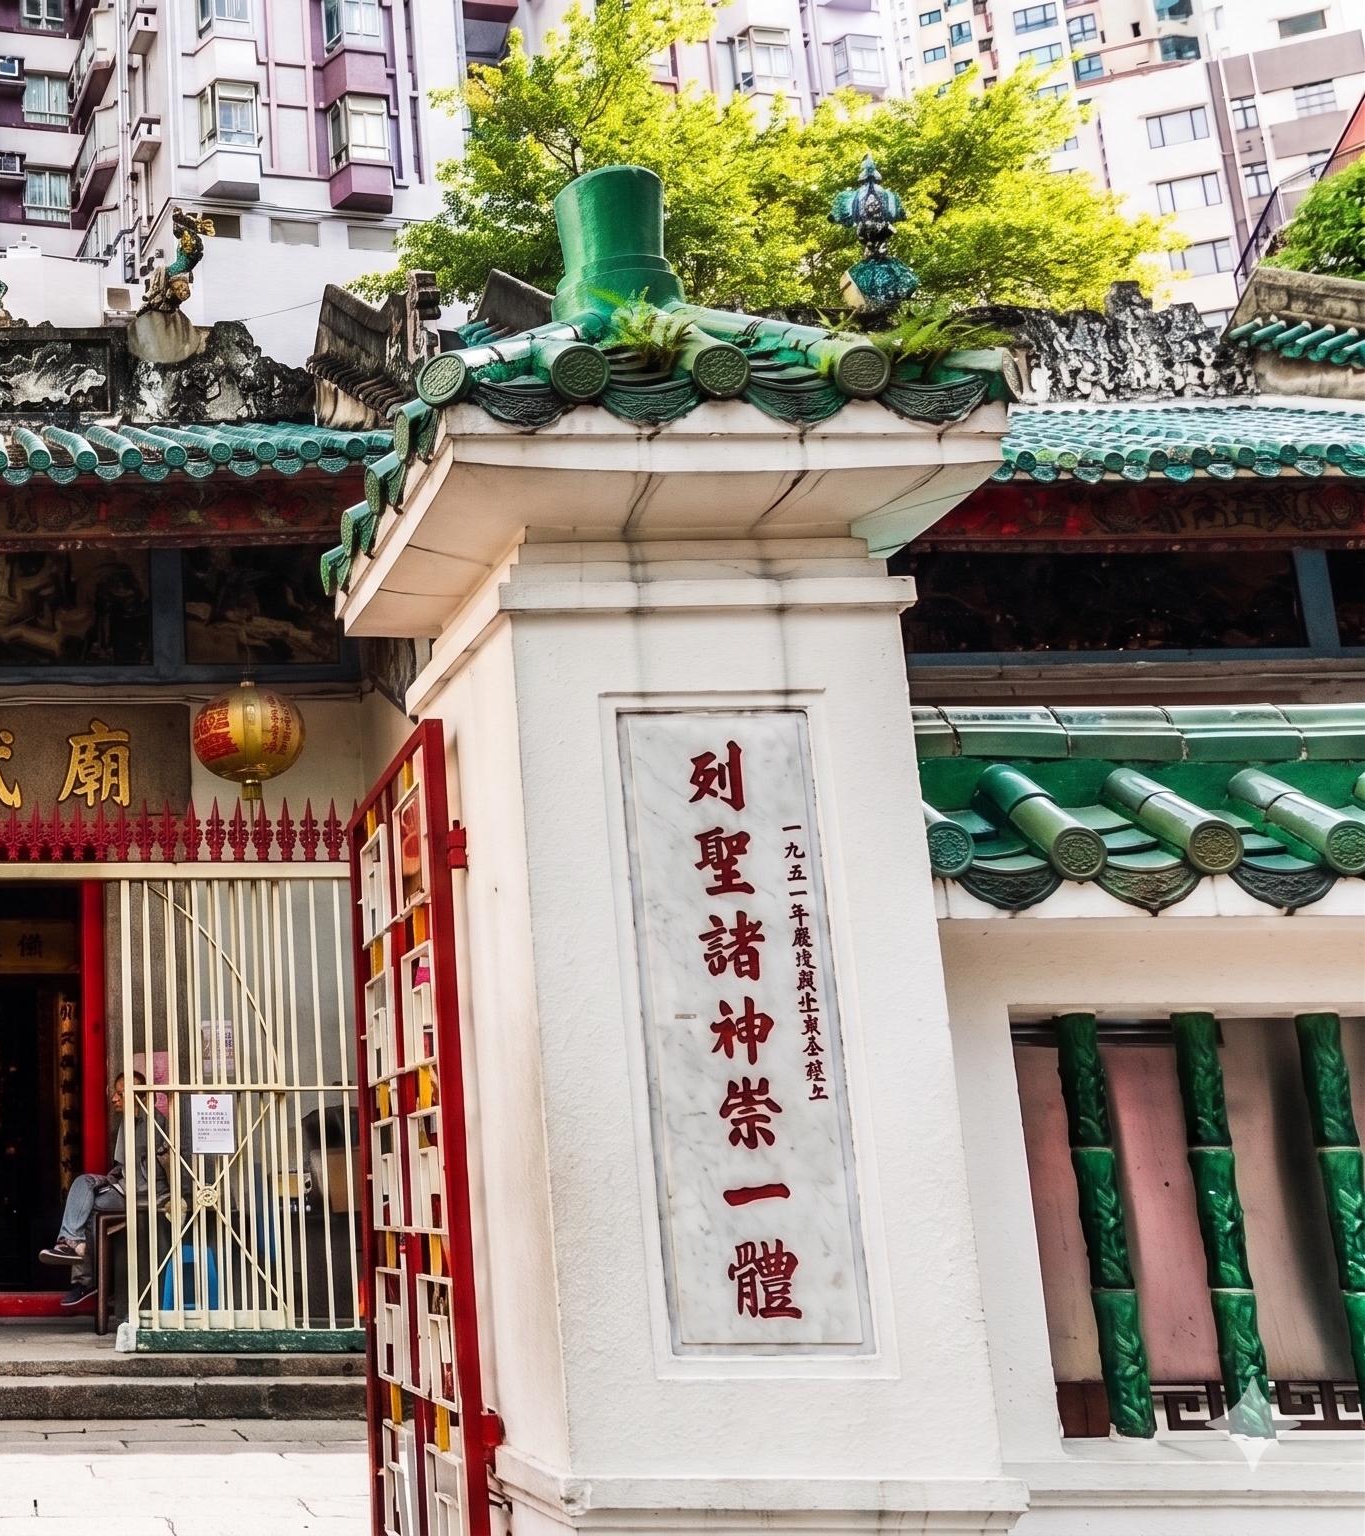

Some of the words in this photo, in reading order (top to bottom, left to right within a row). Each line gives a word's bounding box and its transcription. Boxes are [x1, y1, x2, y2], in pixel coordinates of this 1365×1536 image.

[688, 739, 803, 1320] 列聖諸神崇一體
